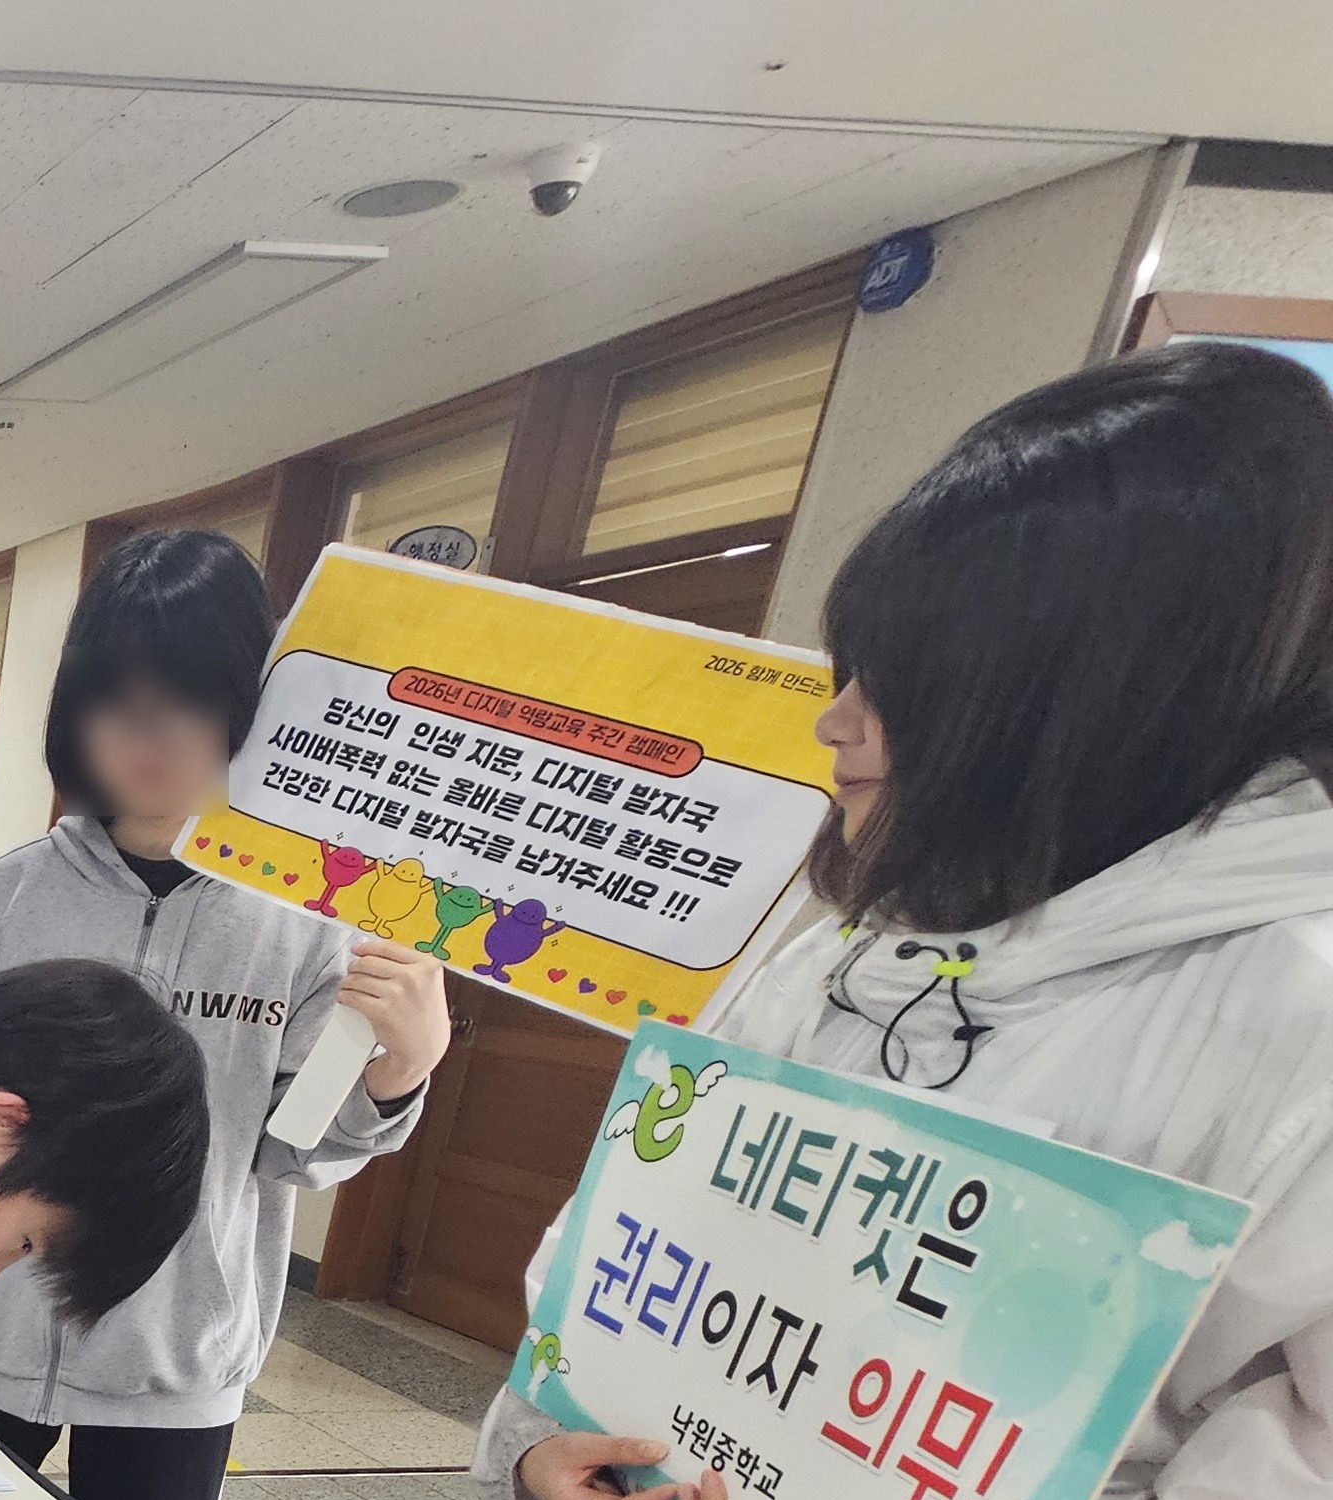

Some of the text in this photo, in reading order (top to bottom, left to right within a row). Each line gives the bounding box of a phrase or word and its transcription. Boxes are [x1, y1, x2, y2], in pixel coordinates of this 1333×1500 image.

[404, 675, 686, 766] 2026년 디지털 역량교육 주간 캠페인
[705, 655, 829, 697] 2026 함께 만드는
[267, 723, 743, 889] 사이버폭력 없는 올바른 디지털 활동으로
[324, 697, 720, 834] 당신의 인생 지문, 디지털 발자국
[262, 761, 701, 923] 건강한 디지털 발자국을 남겨주세요 !!!
[170, 990, 286, 1027] NWMS
[709, 1102, 989, 1322] 네티켓은
[583, 1211, 824, 1412] 권리이자
[669, 1404, 785, 1500] 낙원중학교
